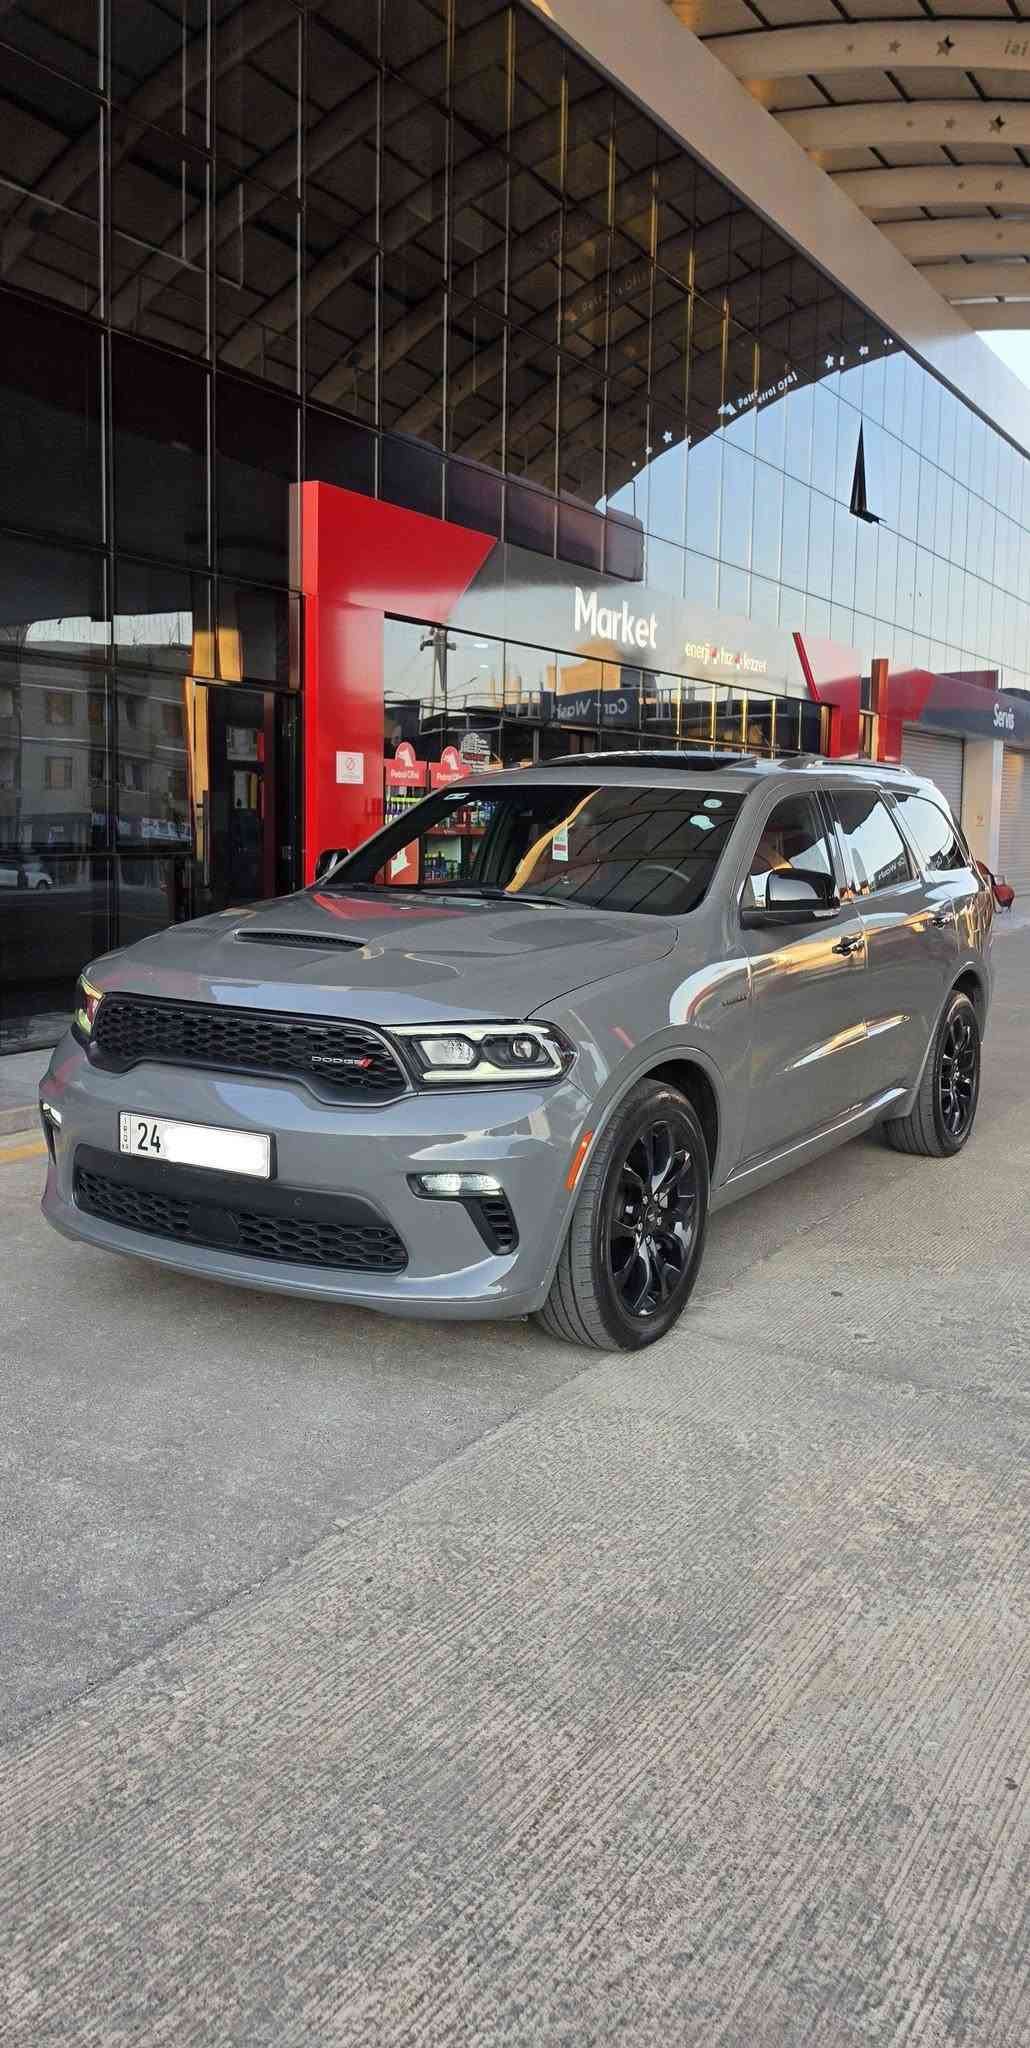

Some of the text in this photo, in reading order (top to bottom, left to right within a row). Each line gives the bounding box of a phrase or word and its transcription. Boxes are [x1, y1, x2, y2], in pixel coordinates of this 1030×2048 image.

[574, 586, 658, 648] Market
[993, 703, 1015, 730] Servis
[311, 1055, 359, 1065] DODGE
[137, 1122, 160, 1153] 24
